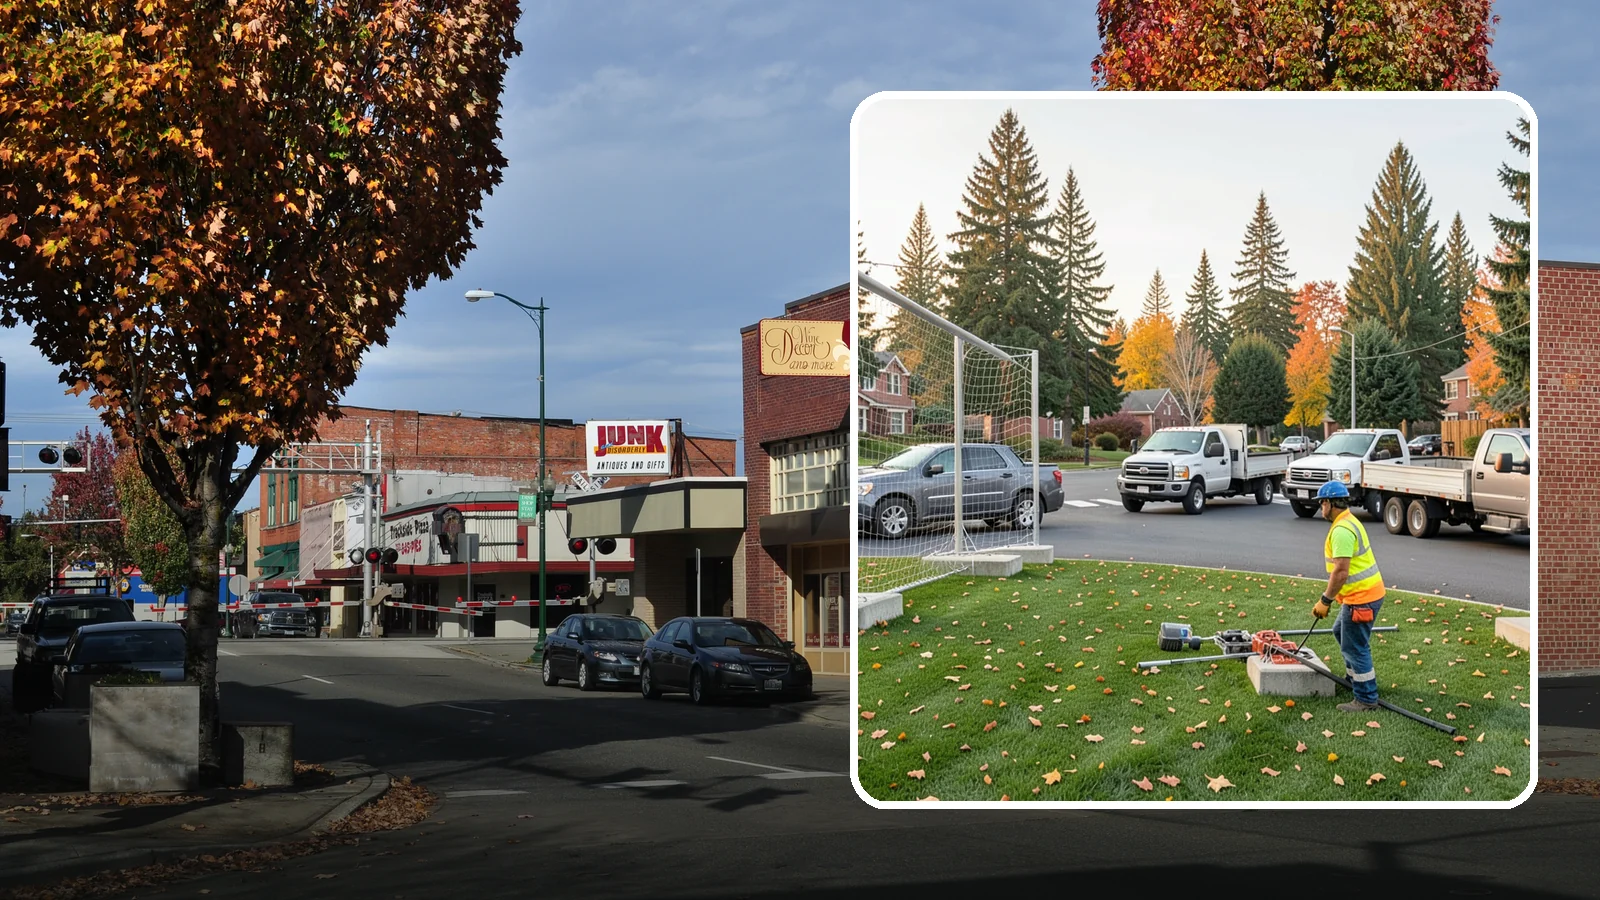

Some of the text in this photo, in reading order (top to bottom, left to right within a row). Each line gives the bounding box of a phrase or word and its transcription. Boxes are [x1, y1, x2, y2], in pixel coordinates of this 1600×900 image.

[595, 425, 665, 457] JUNK
[597, 461, 665, 470] ANTIQUES AND GIFTS
[573, 473, 589, 491] RAIL
[352, 498, 364, 510] CRO
[390, 519, 429, 539] Trackside Pizza
